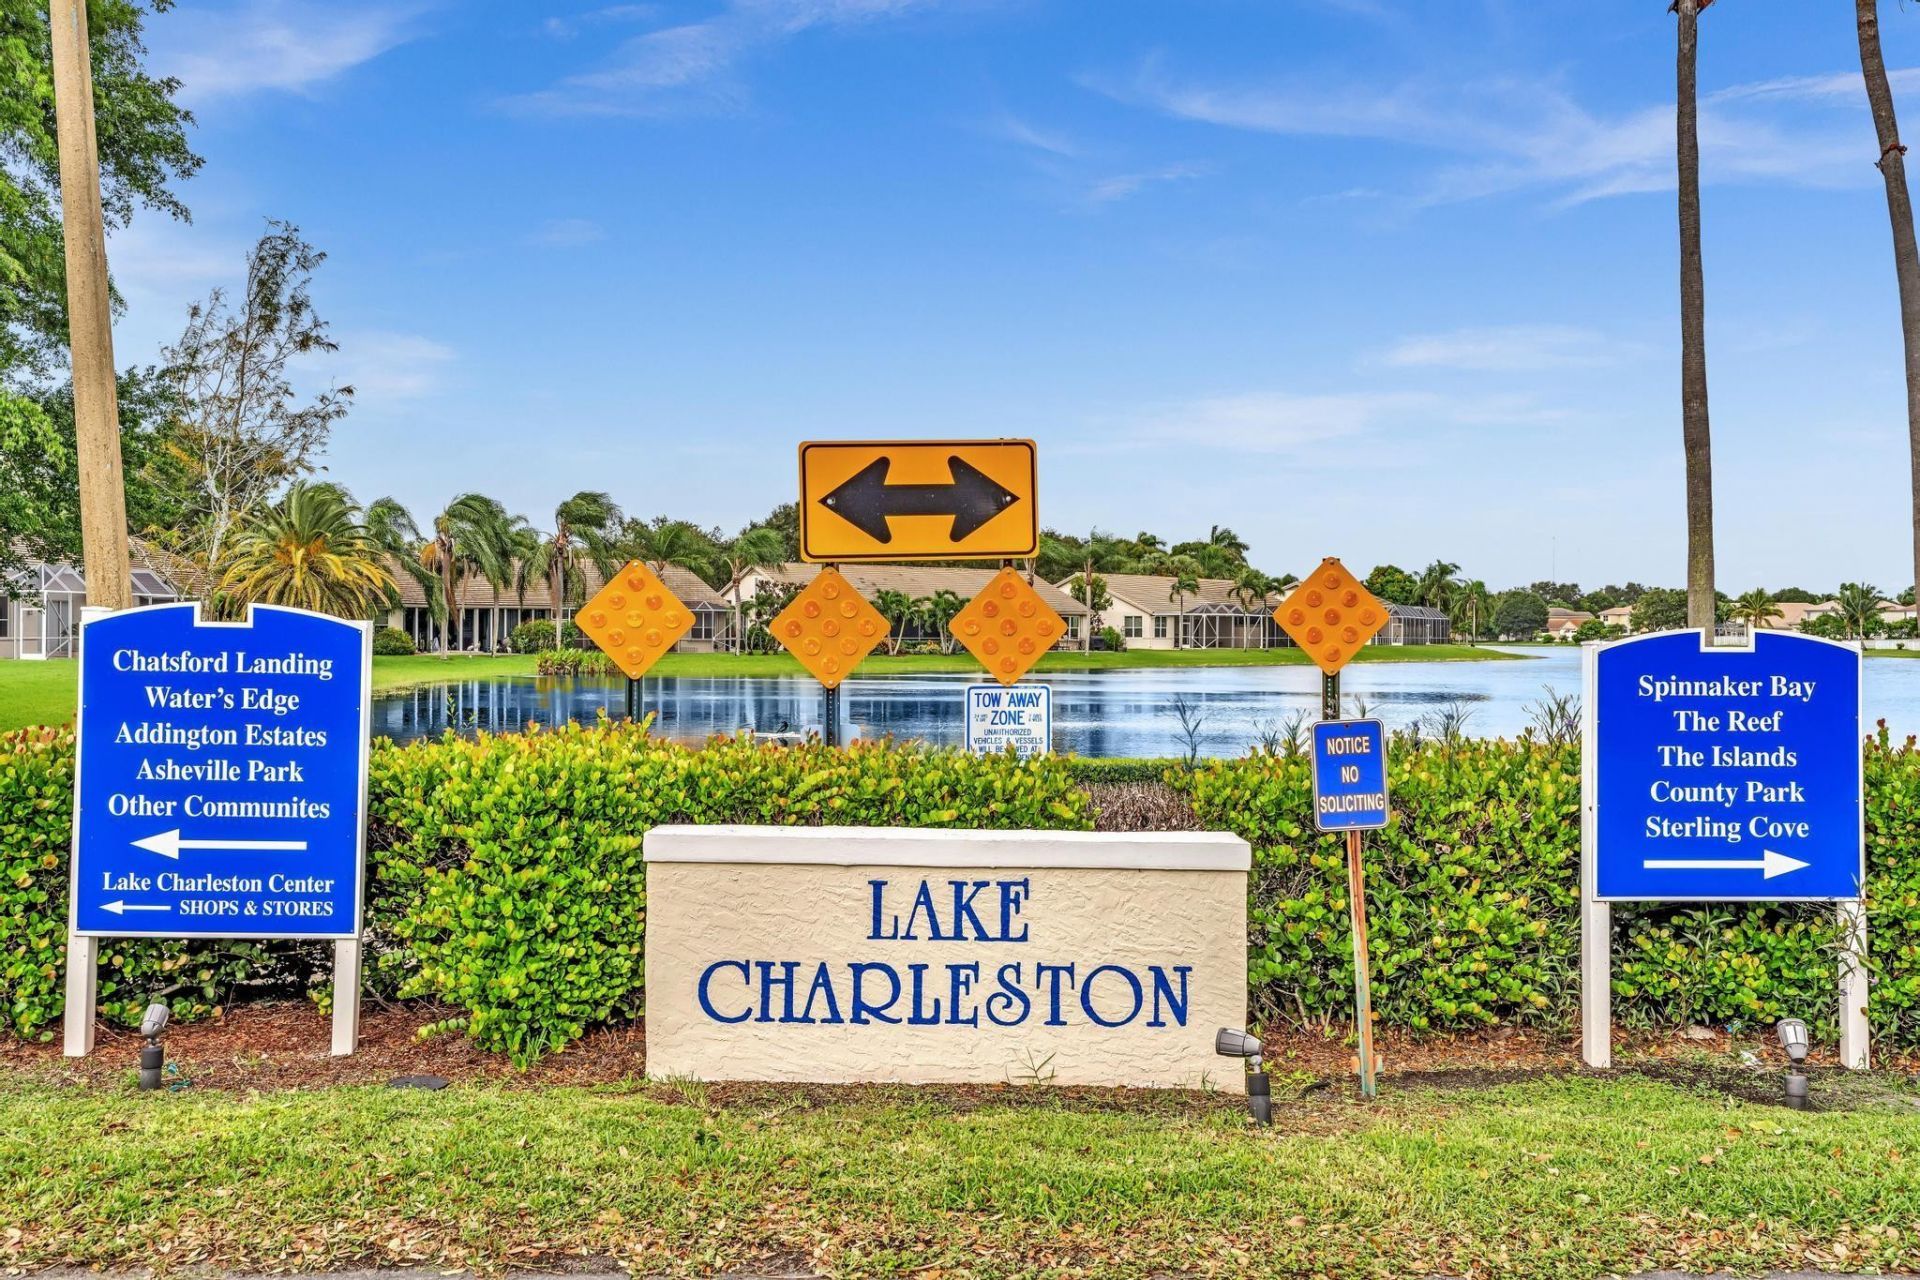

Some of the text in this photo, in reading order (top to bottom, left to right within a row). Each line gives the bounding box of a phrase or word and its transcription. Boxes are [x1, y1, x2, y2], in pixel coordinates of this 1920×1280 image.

[113, 650, 332, 680] Chatsford Landing
[974, 692, 1041, 707] TOW AWAY
[1639, 675, 1815, 702] Spinnaker Bay
[145, 687, 299, 715] Water's Edge
[990, 710, 1025, 725] ZONE
[1674, 711, 1783, 731] The Reef
[115, 722, 326, 750] Addington Estates
[1327, 737, 1370, 755] NOTICE
[1658, 746, 1796, 766] The Islands
[137, 759, 303, 781] Asheville Park
[1342, 766, 1359, 783] NO
[1320, 794, 1384, 813] SOLICITING
[1651, 781, 1804, 807] County Park
[109, 794, 329, 818] Other Communites
[1647, 816, 1808, 842] Sterling Cove
[103, 872, 334, 892] Lake Charleston Center
[180, 900, 333, 916] SHOPS & STORES
[867, 878, 1029, 943] LAKE
[698, 960, 1192, 1028] CHARLESTON
